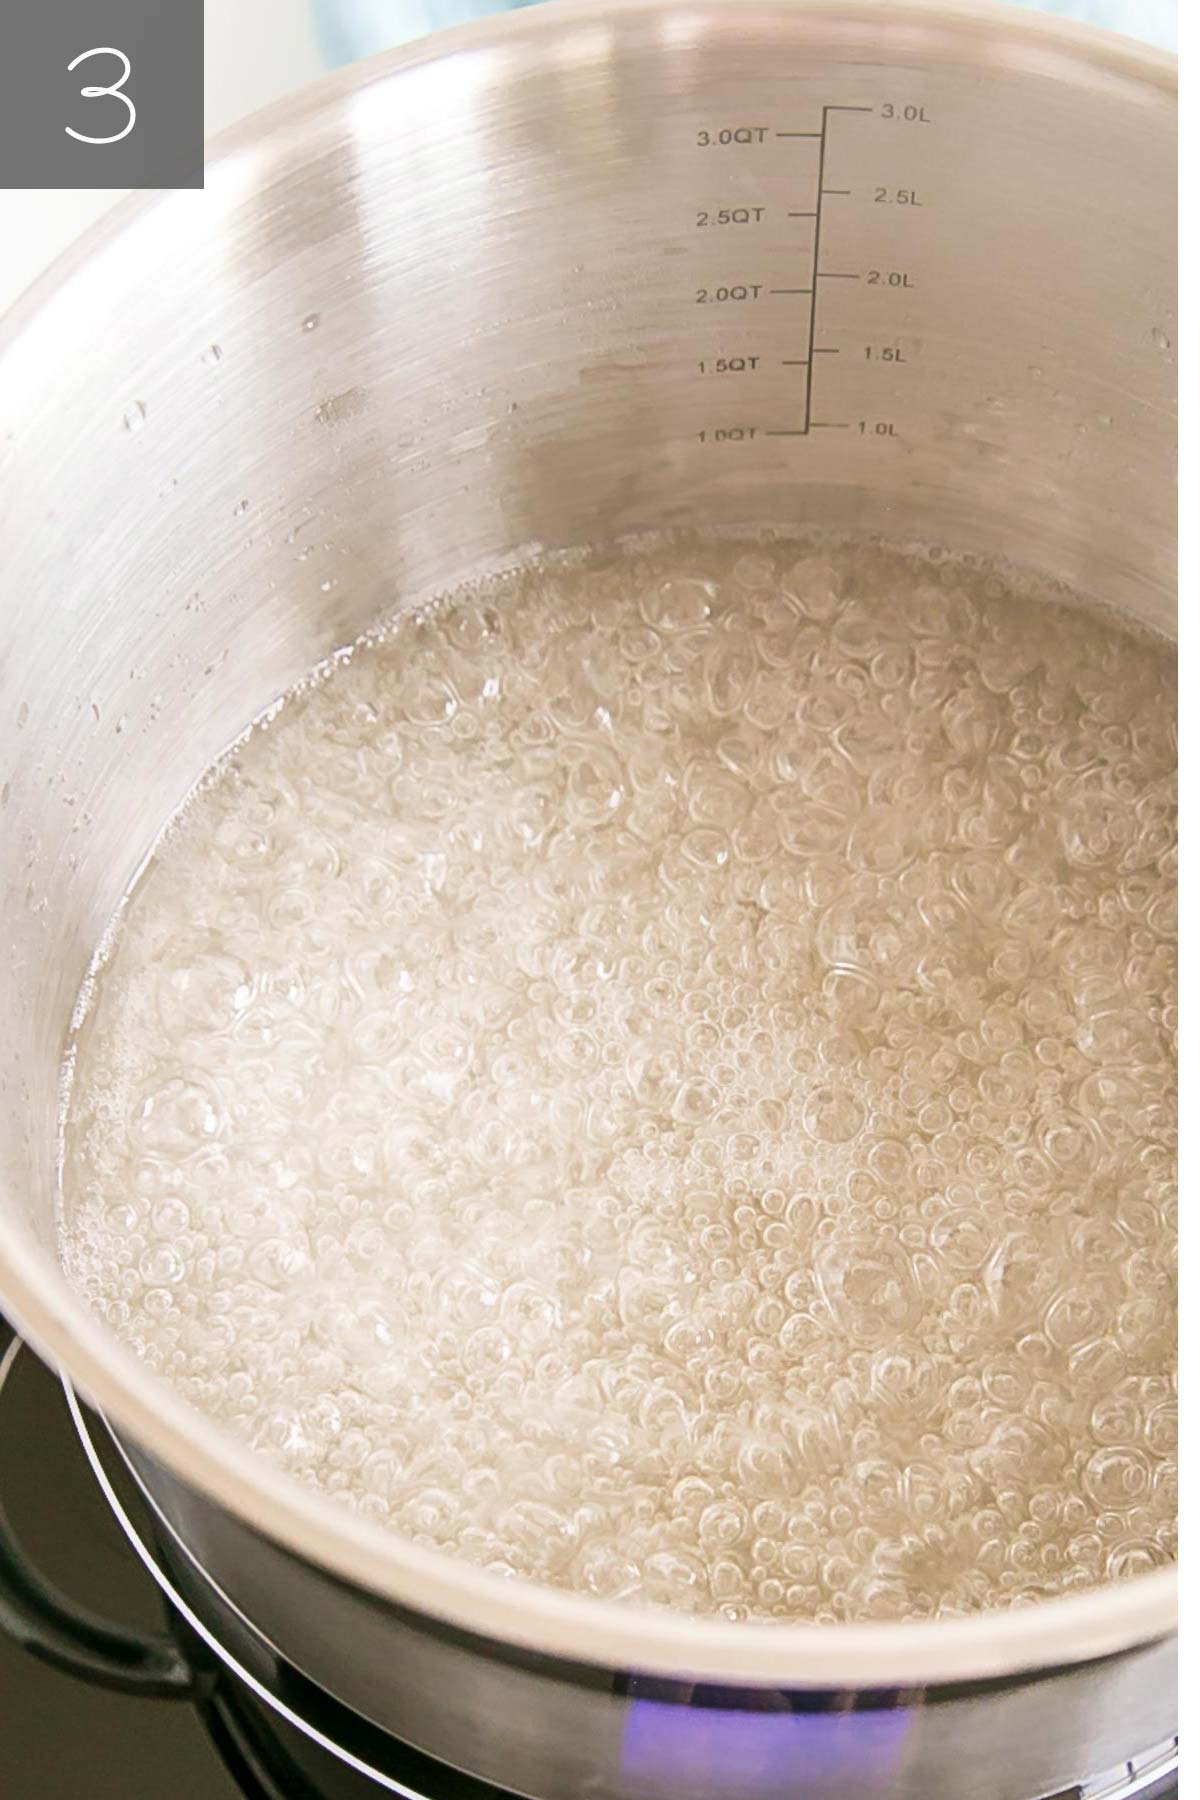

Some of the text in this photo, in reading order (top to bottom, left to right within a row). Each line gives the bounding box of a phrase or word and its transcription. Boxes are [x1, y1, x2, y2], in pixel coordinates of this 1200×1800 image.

[881, 103, 931, 122] 3.0L
[697, 127, 769, 147] 3.0QT
[874, 187, 923, 206] 2.5L
[696, 208, 765, 227] 2.5QT
[867, 270, 915, 288] 2.0L
[695, 285, 763, 303] 2.0QT
[864, 346, 907, 363] 1.5L
[698, 357, 760, 374] 1.5QT
[697, 428, 757, 443] 10QT
